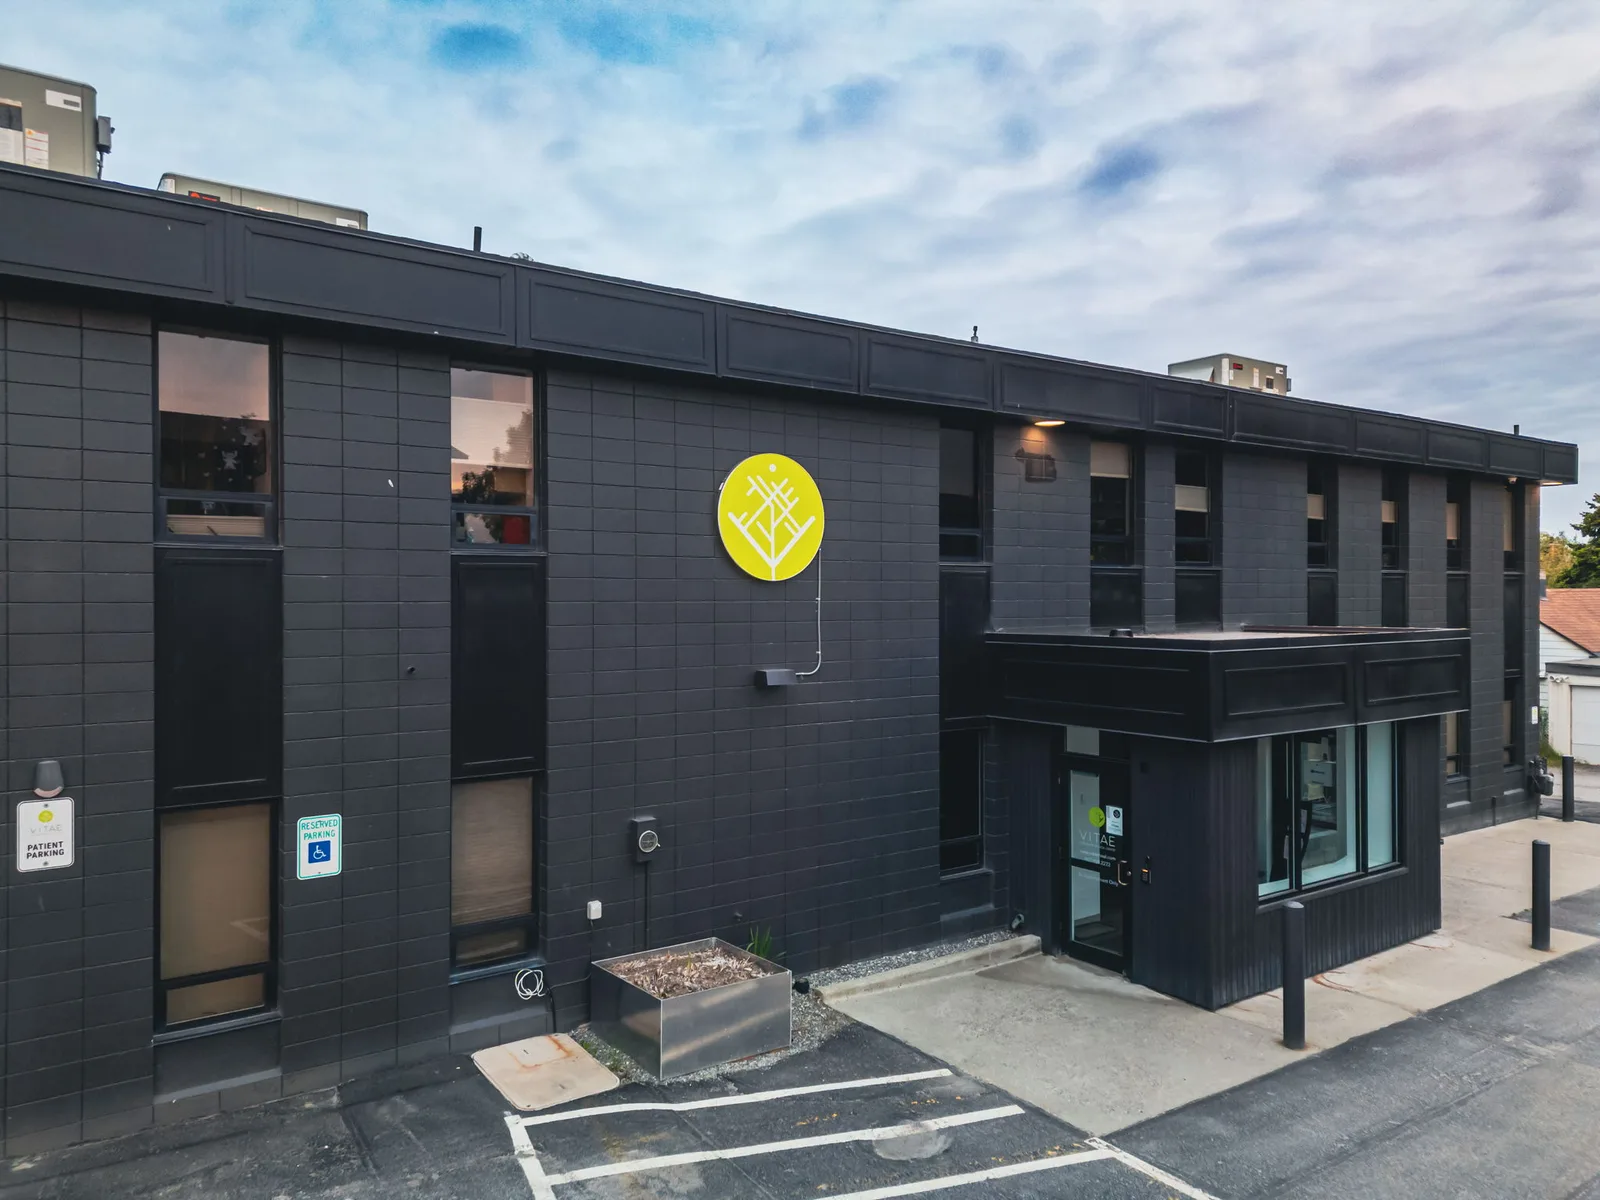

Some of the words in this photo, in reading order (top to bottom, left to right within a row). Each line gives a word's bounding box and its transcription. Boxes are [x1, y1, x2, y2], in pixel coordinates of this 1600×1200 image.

[30, 824, 62, 833] VITAE
[301, 820, 338, 830] RESERVED
[304, 830, 335, 840] PARKING
[1079, 829, 1116, 848] VITAE
[27, 841, 64, 851] PATIENT
[27, 849, 64, 859] PARKING
